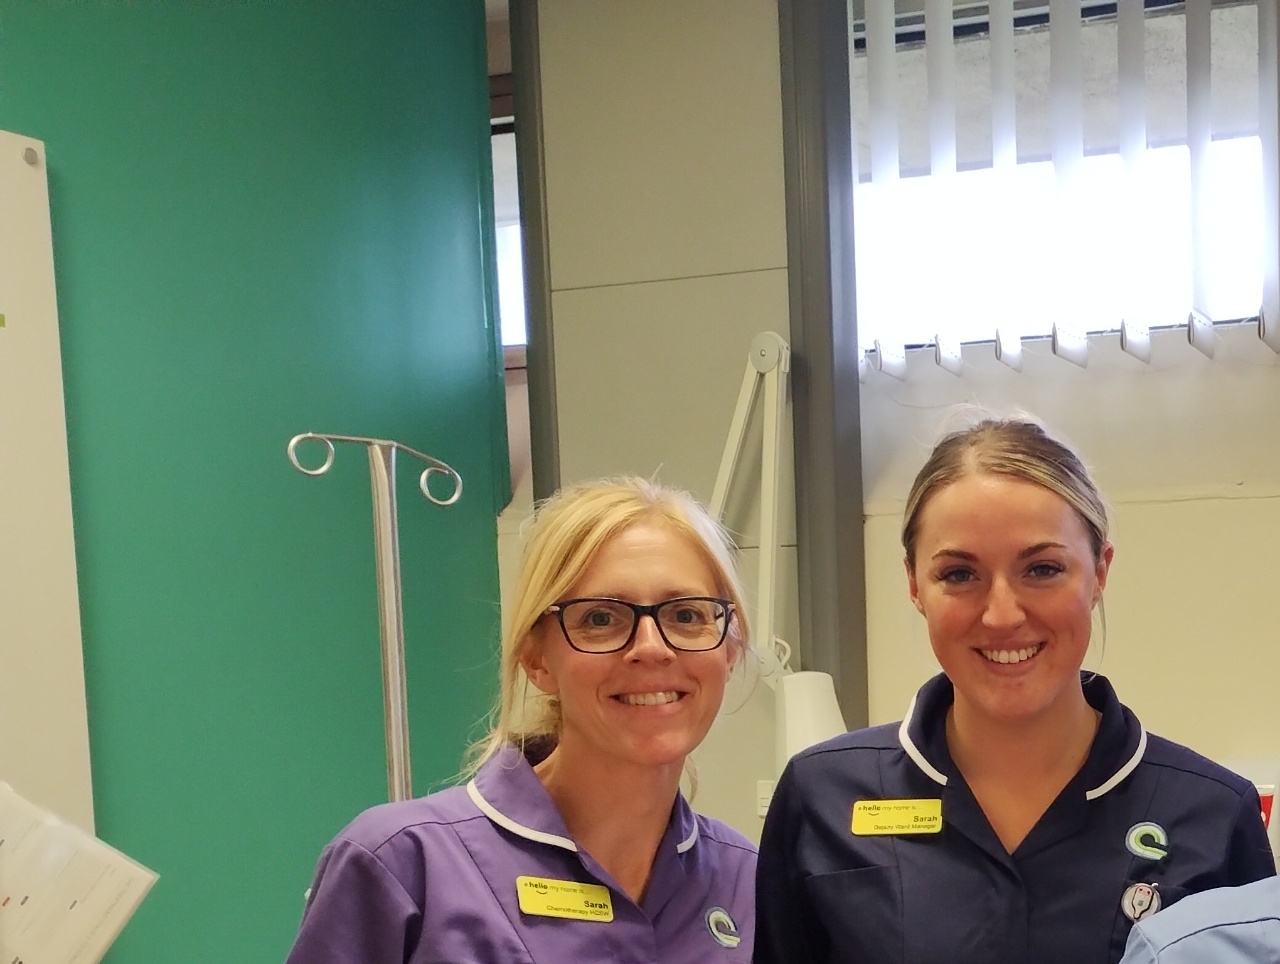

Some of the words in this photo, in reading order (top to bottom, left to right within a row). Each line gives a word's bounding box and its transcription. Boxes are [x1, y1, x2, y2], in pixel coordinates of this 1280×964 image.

[913, 815, 938, 823] Sarah
[546, 904, 588, 916] Chemotherapy
[583, 900, 609, 910] Sarah
